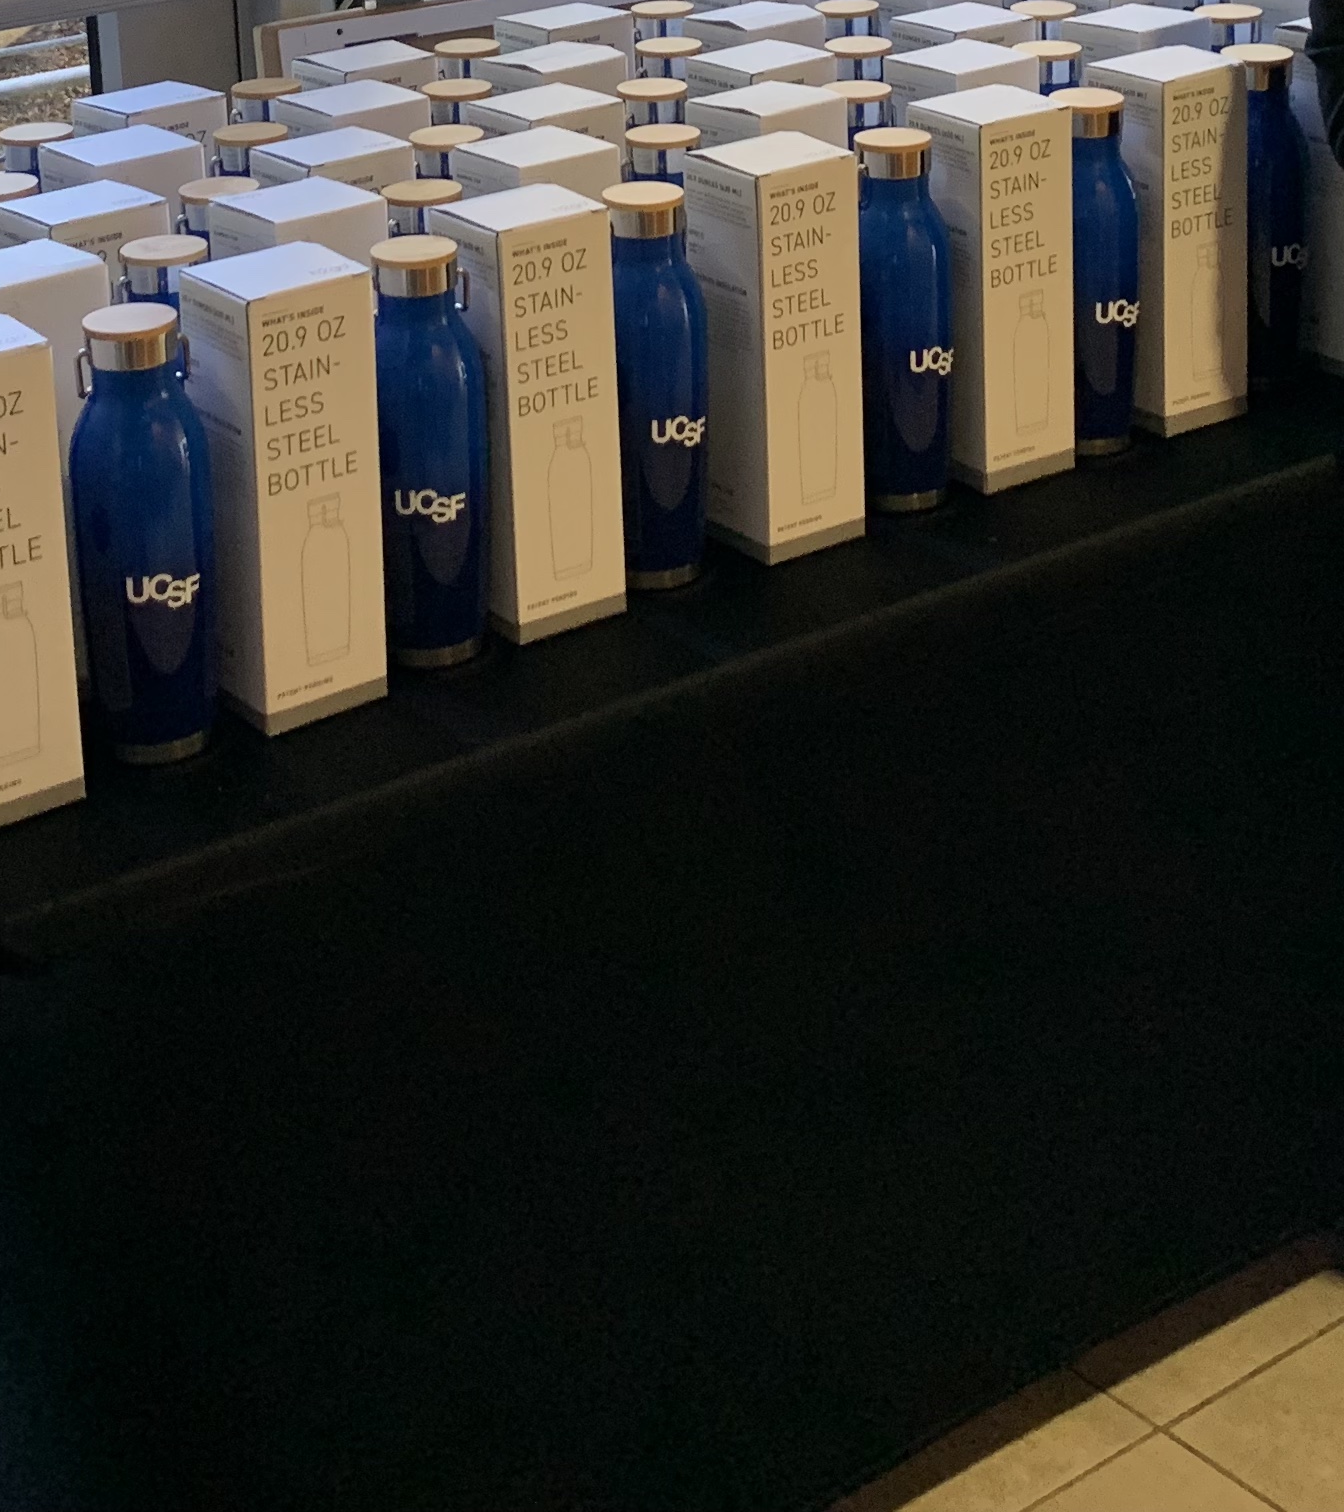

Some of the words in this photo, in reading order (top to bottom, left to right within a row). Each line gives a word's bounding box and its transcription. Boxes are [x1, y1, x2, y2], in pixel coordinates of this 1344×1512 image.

[1172, 102, 1203, 125] 20.9
[1209, 96, 1229, 117] OZ
[989, 145, 1023, 170] 20.9
[1030, 138, 1051, 161] OZ
[1171, 127, 1225, 154] STAIN-
[1171, 156, 1212, 182] LESS
[797, 181, 819, 194] INSIDE
[990, 171, 1047, 200] STAIN-
[1171, 183, 1223, 210] STEEL
[770, 199, 805, 226] 20.9
[813, 191, 836, 215] OZ
[990, 201, 1034, 230] LESS
[1171, 207, 1233, 239] BOTTLE
[543, 238, 568, 251] INSIDE
[771, 225, 832, 257] STAIN-
[991, 230, 1045, 259] STEEL
[512, 256, 552, 286] 20.9
[561, 248, 587, 273] OZ
[771, 259, 818, 288] LESS
[991, 253, 1057, 289] BOTTLE
[262, 314, 294, 328] WHAT'S
[297, 304, 325, 320] INSIDE
[514, 284, 583, 318] STAIN-
[772, 288, 831, 319] STEEL
[1095, 299, 1140, 328] UCSF
[262, 325, 307, 357] 20.9
[317, 315, 346, 342] OZ
[515, 319, 568, 352] LESS
[773, 313, 845, 350] BOTTLE
[264, 354, 340, 392] STAIN-
[517, 350, 583, 384] STEEL
[910, 346, 954, 376] UCSF
[265, 391, 325, 427] LESS
[518, 376, 599, 417] BOTTLE
[267, 424, 341, 462] STEEL
[651, 415, 706, 447] UCSF
[268, 450, 358, 497] BOTTLE
[395, 489, 467, 524] UCSF
[125, 573, 200, 609] UCSF
